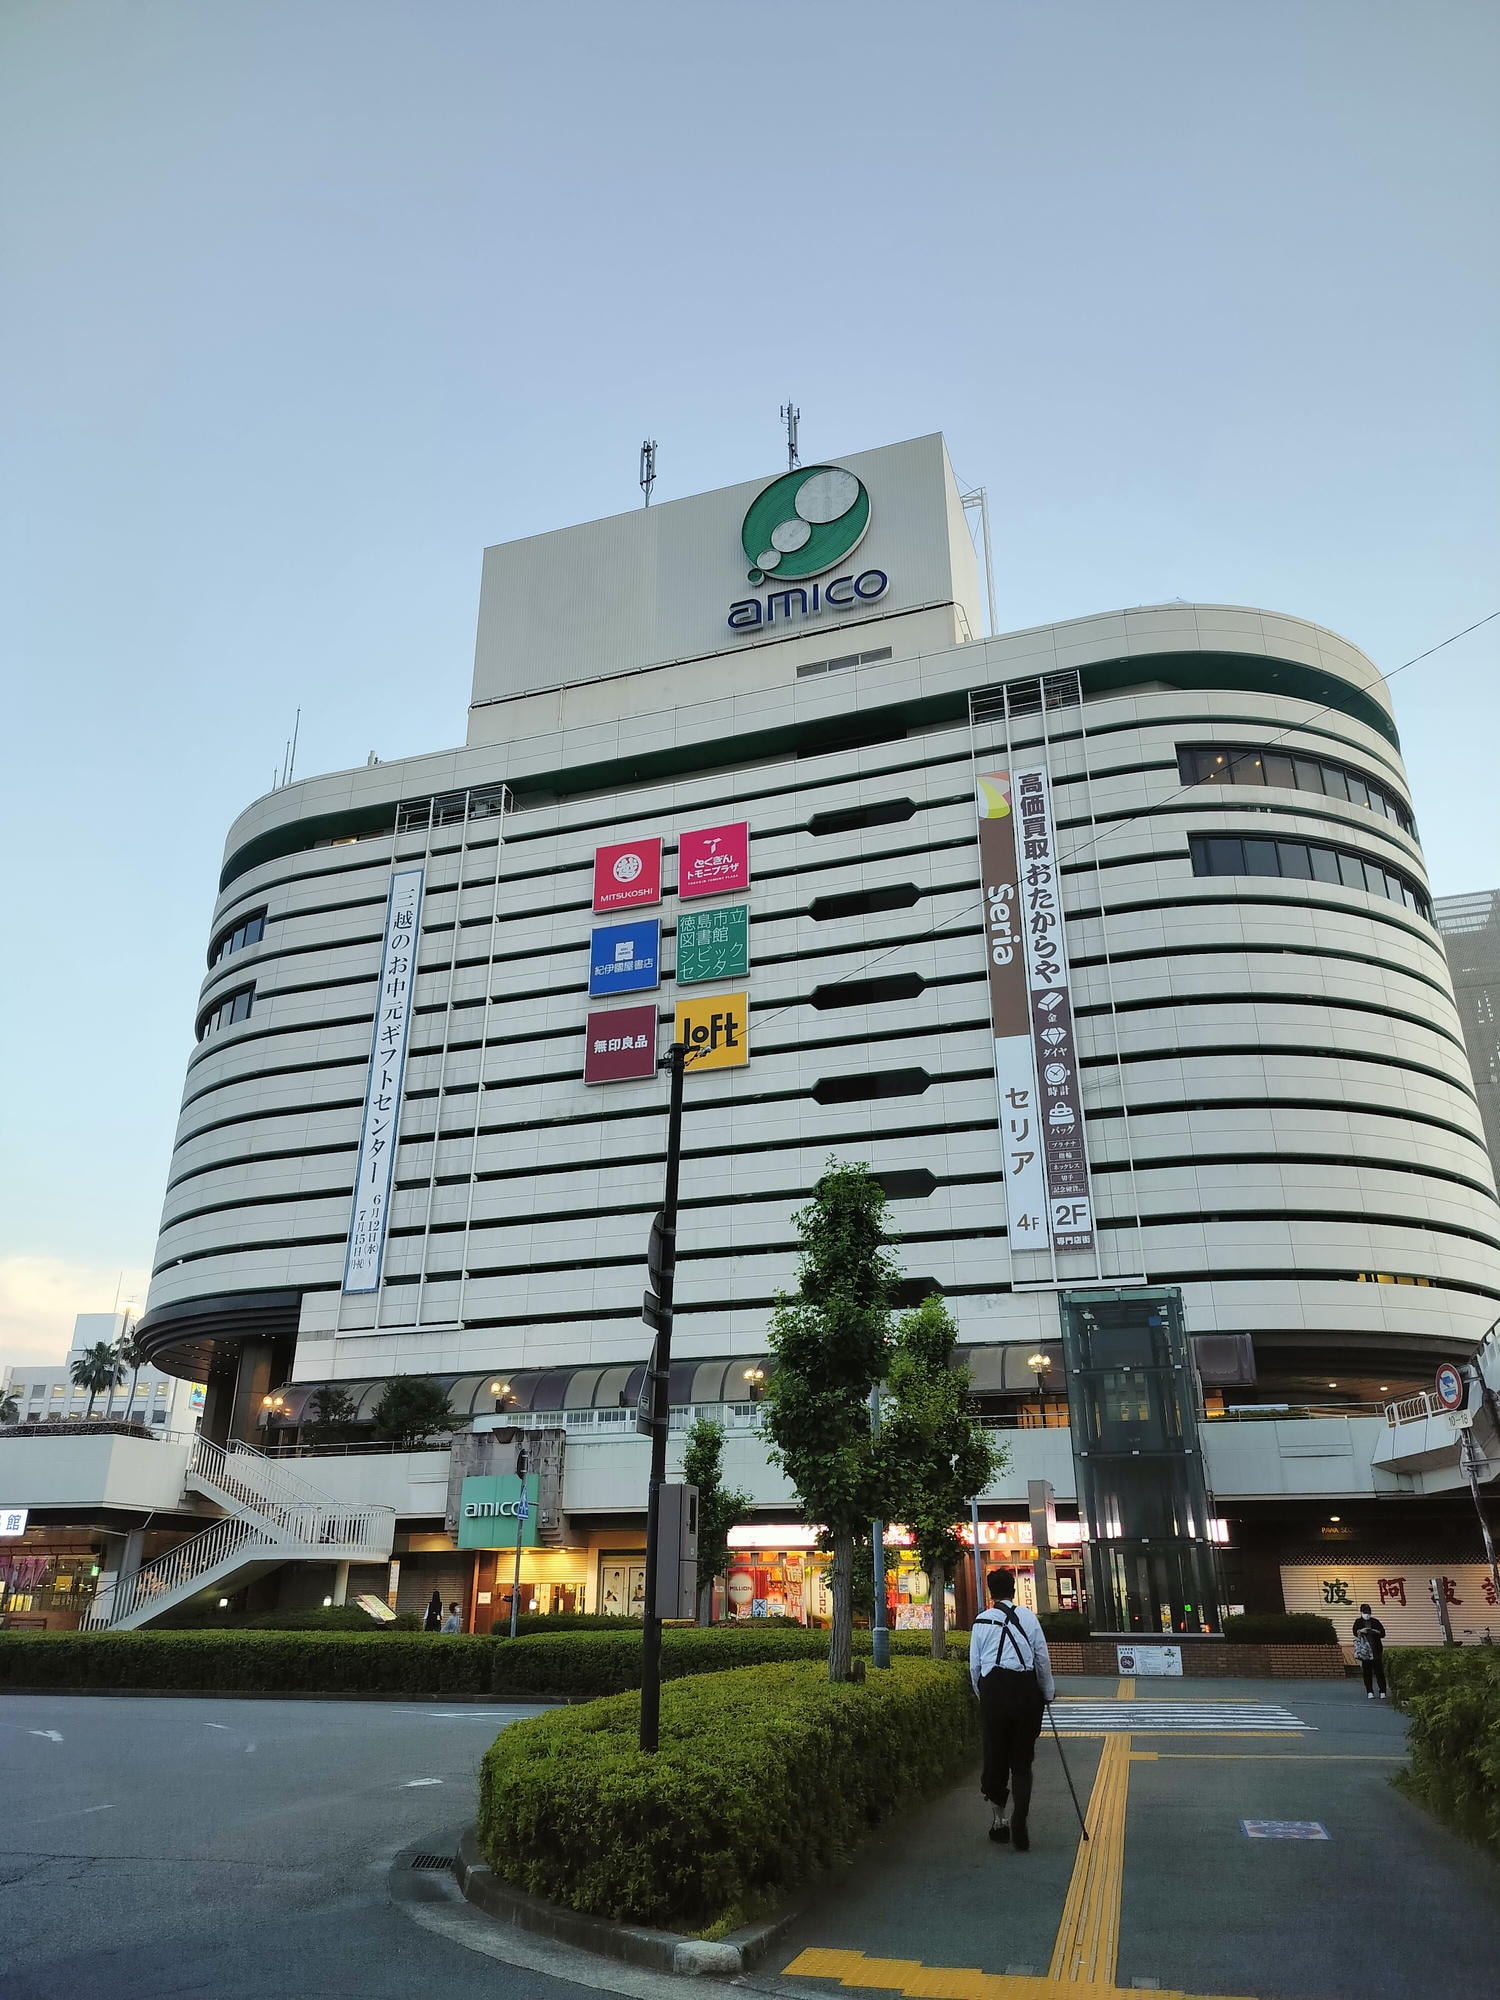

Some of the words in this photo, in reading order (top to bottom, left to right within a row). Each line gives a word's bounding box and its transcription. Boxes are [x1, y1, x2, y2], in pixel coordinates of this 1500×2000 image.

[727, 568, 889, 633] amico
[693, 853, 733, 869] とくぎん
[687, 863, 739, 880] トモニプラザ
[600, 887, 653, 902] MITSUKOSHI
[680, 909, 745, 932] 徳島市立
[988, 882, 1021, 966] Seria
[680, 926, 729, 948] 図書館
[680, 942, 743, 965] シビック
[594, 957, 654, 976] 紀伊國屋書店
[680, 960, 745, 980] センター
[1047, 1014, 1057, 1023] 金
[369, 887, 416, 1185] 三越のお中元ギフトセンター
[593, 1033, 648, 1053] 無印良品
[1042, 1047, 1068, 1057] ダイヤ
[1047, 1086, 1070, 1096] 時計
[1005, 1087, 1034, 1175] セリア
[1050, 1124, 1075, 1135] バッグ
[1016, 1213, 1040, 1231] 4F
[1055, 1203, 1087, 1226] 2F
[0, 1514, 21, 1531] 館
